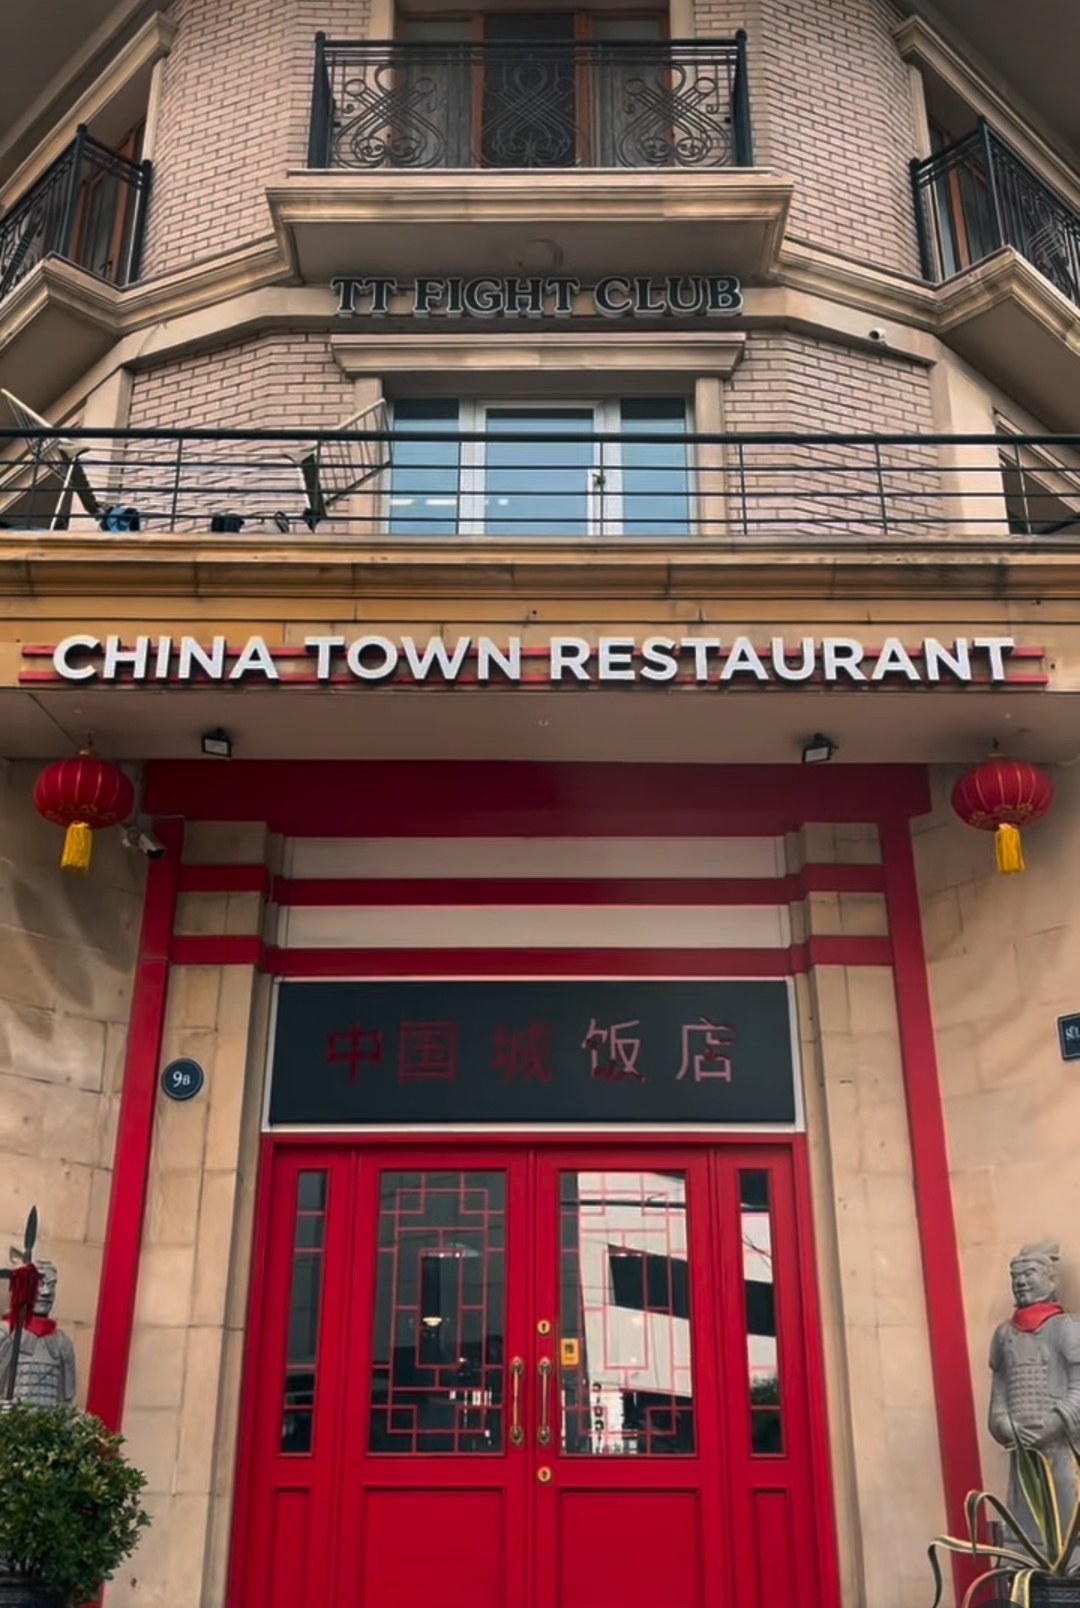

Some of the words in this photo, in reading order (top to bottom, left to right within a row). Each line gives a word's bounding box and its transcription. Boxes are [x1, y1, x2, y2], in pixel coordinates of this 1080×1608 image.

[331, 277, 398, 317] TT
[412, 277, 580, 318] FIGHT
[594, 275, 744, 317] CLUB
[53, 635, 280, 681] CHINA
[304, 635, 521, 681] TOWN
[549, 636, 1015, 682] RESTAURANT
